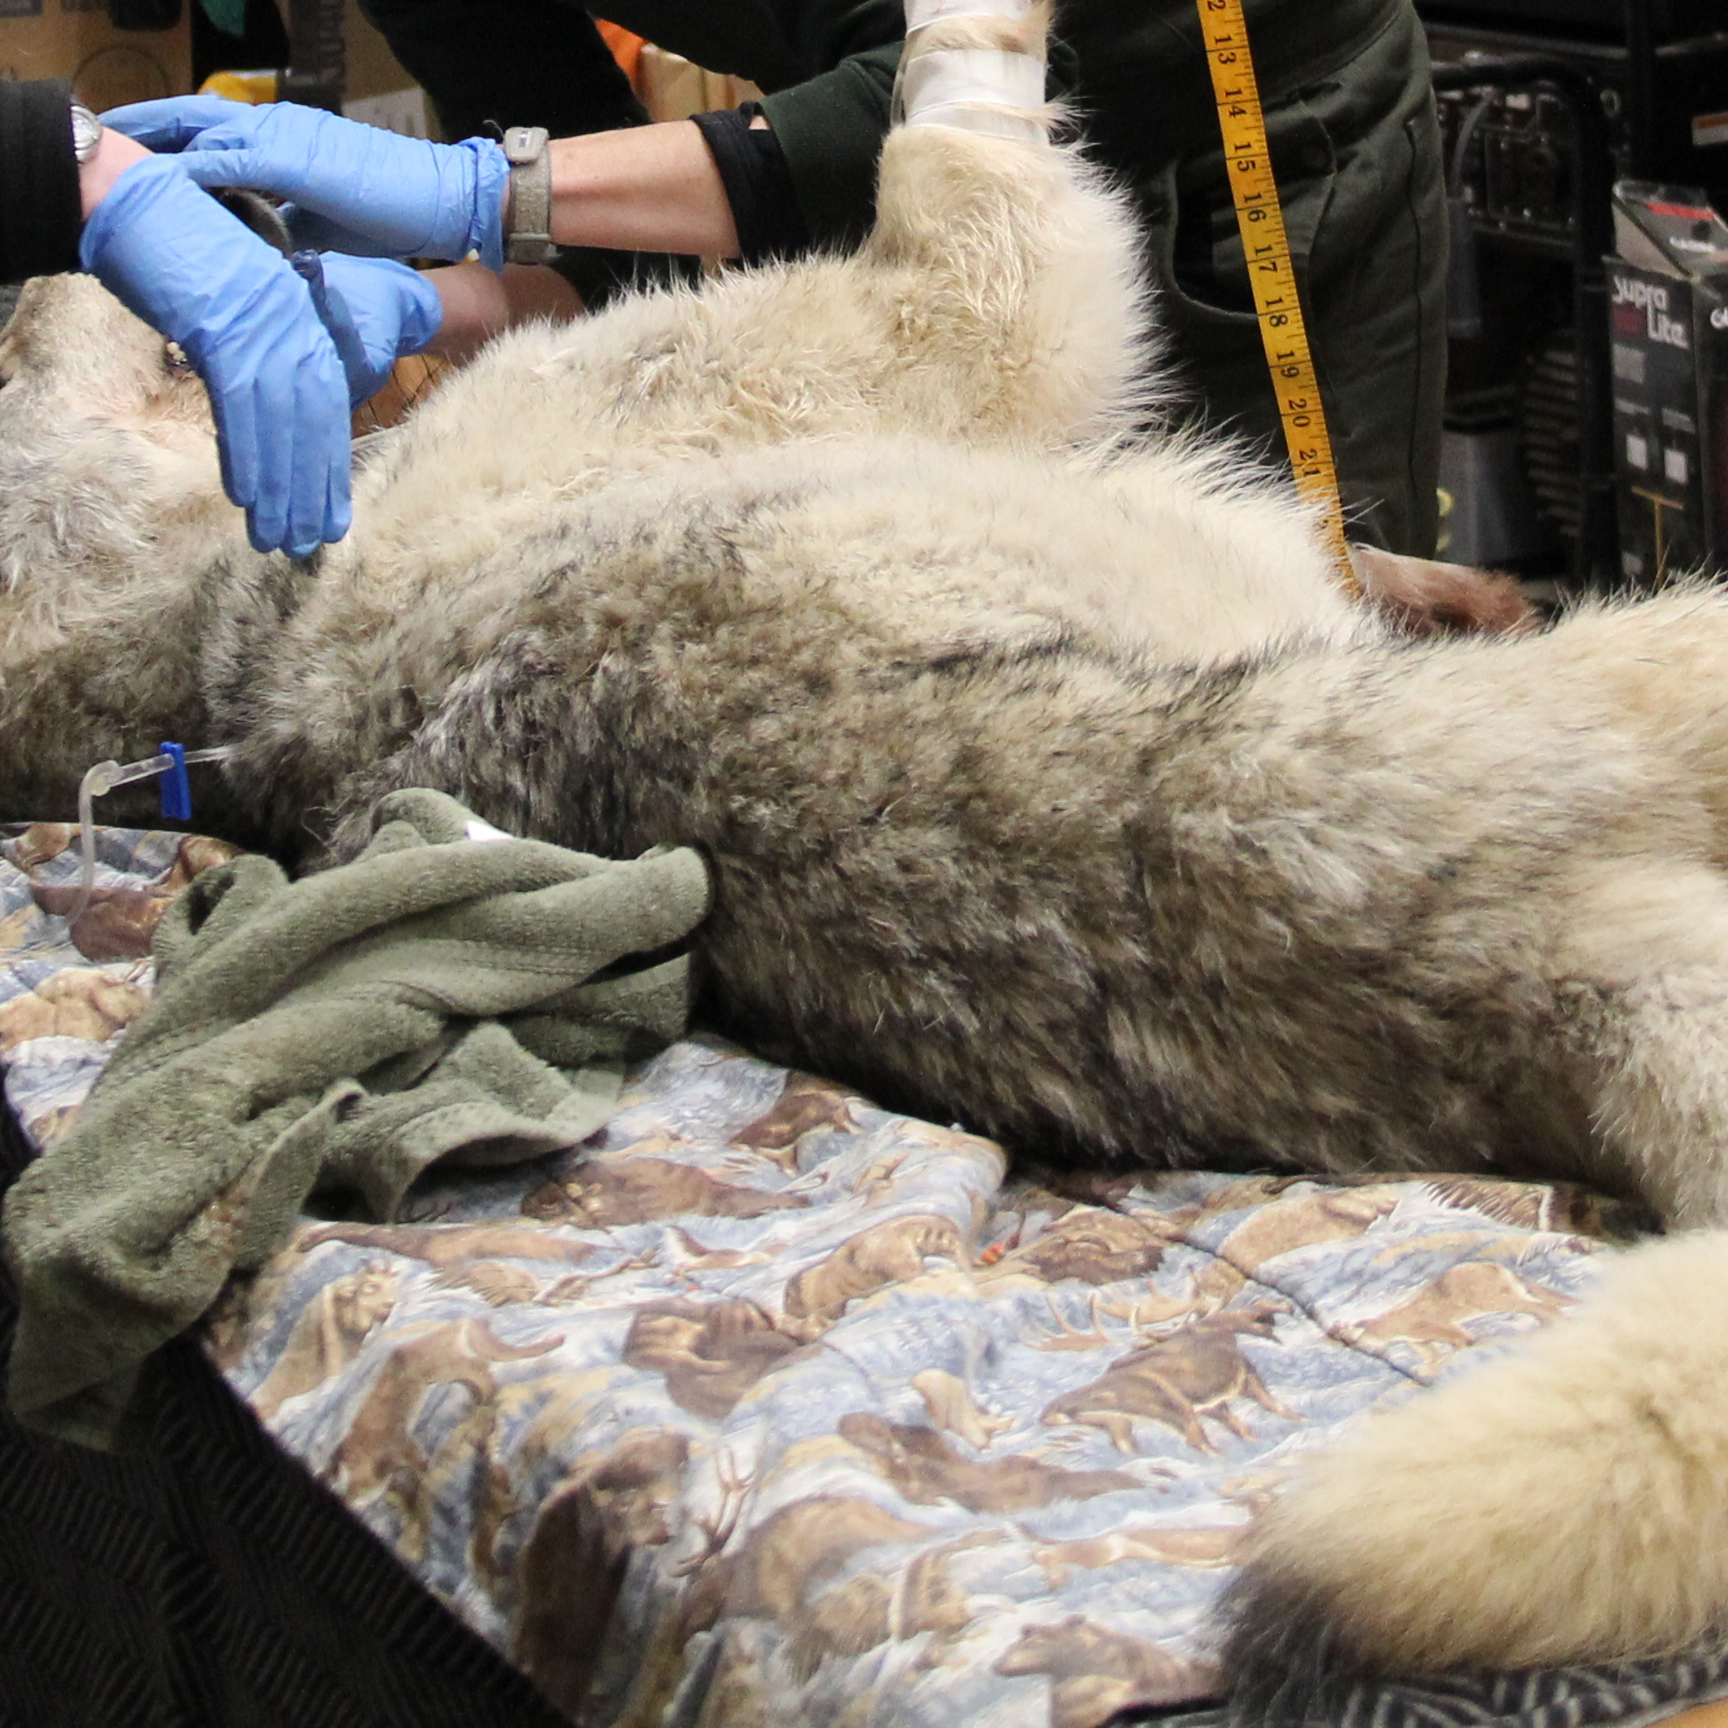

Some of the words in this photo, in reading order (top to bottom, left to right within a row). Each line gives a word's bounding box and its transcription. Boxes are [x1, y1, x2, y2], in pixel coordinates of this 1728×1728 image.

[1214, 34, 1237, 65] 13
[1225, 88, 1247, 118] 14
[1234, 141, 1256, 172] 15
[1243, 193, 1267, 222] 16
[1254, 244, 1278, 273] 17
[1265, 297, 1288, 326] 18
[1277, 349, 1300, 378] 19
[1287, 398, 1311, 428] 20
[1299, 449, 1321, 477] 21
